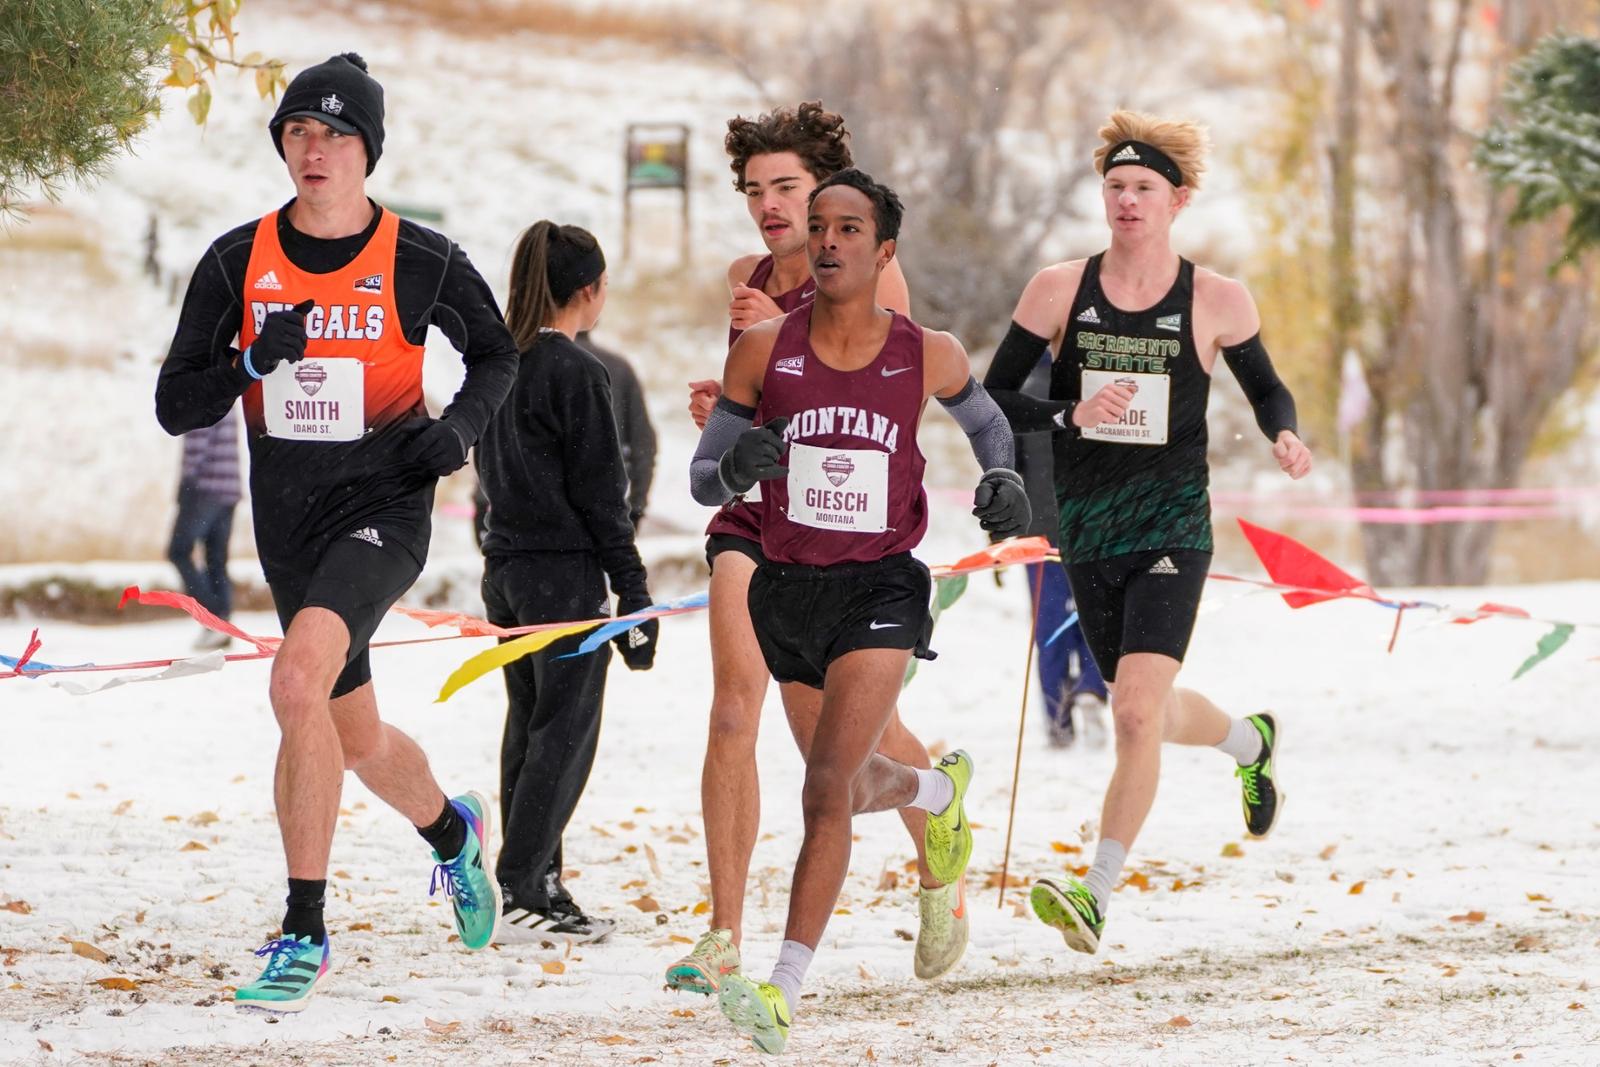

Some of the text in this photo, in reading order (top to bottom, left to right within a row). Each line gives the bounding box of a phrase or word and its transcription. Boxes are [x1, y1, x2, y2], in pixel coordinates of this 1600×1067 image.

[251, 301, 385, 340] BGALS
[1077, 315, 1101, 323] adidas
[1076, 331, 1181, 357] SACRAMENTO
[1086, 351, 1166, 373] STATE
[285, 400, 339, 420] SMITH
[293, 424, 332, 434] IDAHO ST.
[783, 407, 898, 449] MONTANA
[1095, 427, 1140, 437] SACRAMENTO
[806, 488, 868, 512] GIESCH
[815, 512, 855, 525] MONTANA
[349, 532, 383, 547] adidas
